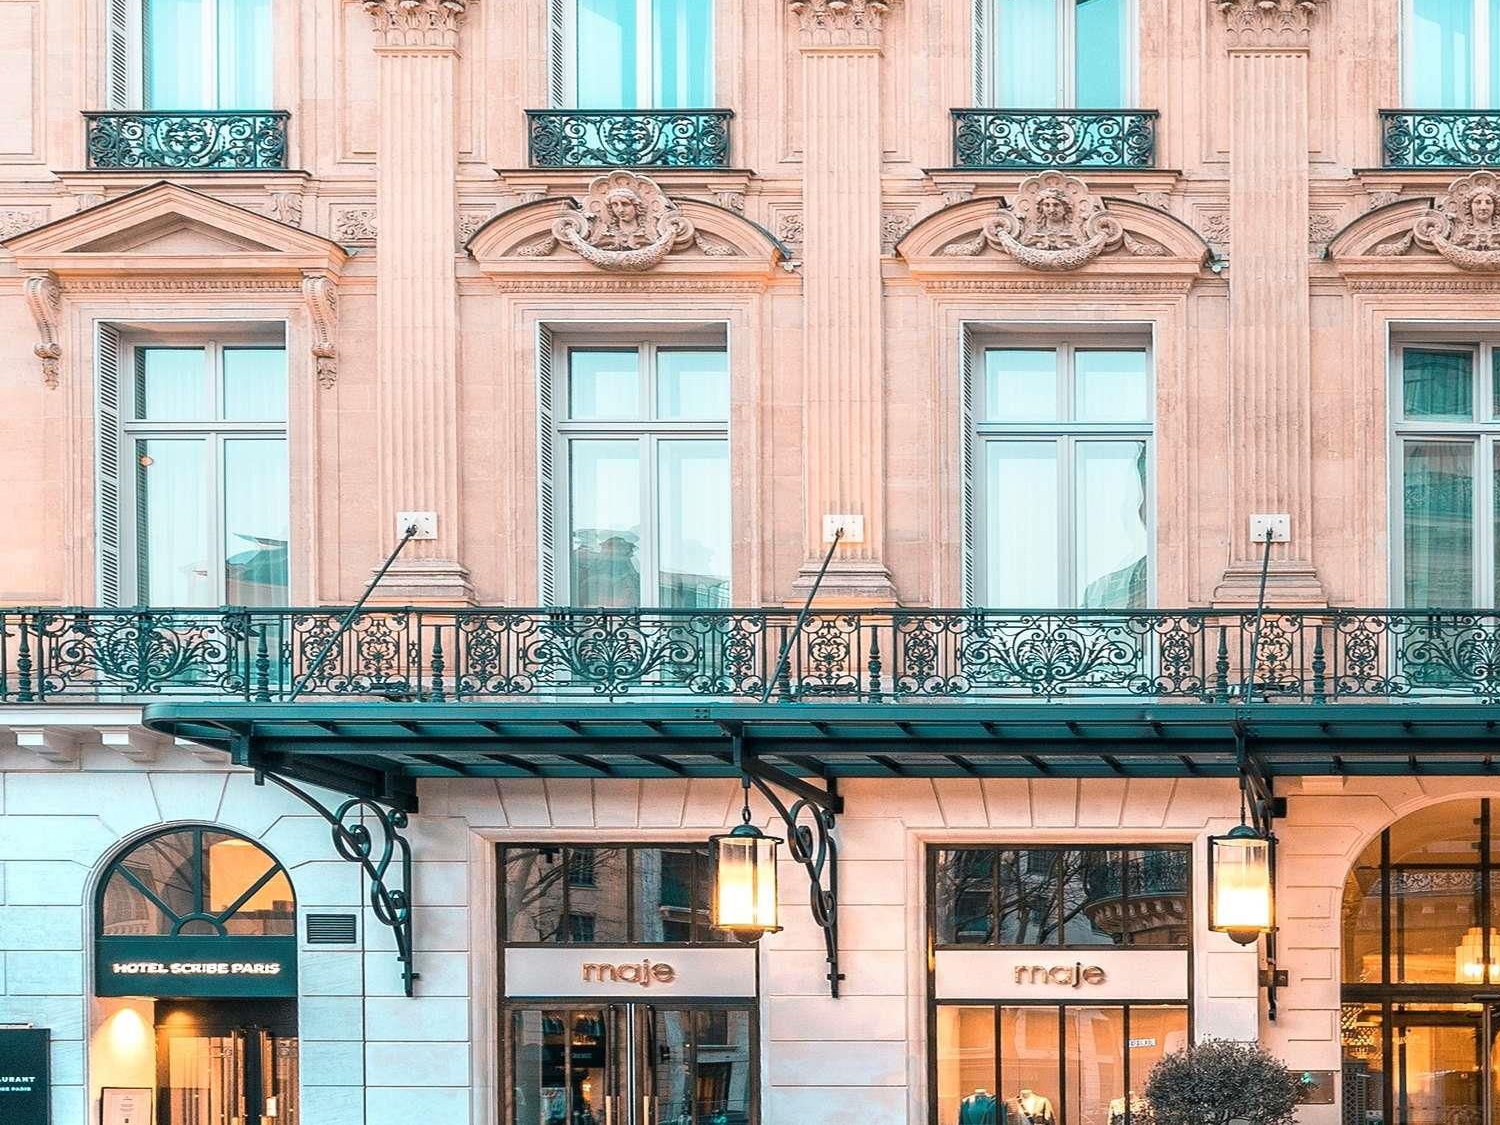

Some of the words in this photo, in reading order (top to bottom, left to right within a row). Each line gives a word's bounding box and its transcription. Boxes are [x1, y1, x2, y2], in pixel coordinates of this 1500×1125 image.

[112, 962, 168, 974] HOTEL
[170, 962, 229, 975] SCRIBE
[231, 962, 281, 974] PARIS
[582, 958, 676, 987] maje
[1014, 961, 1107, 989] maje
